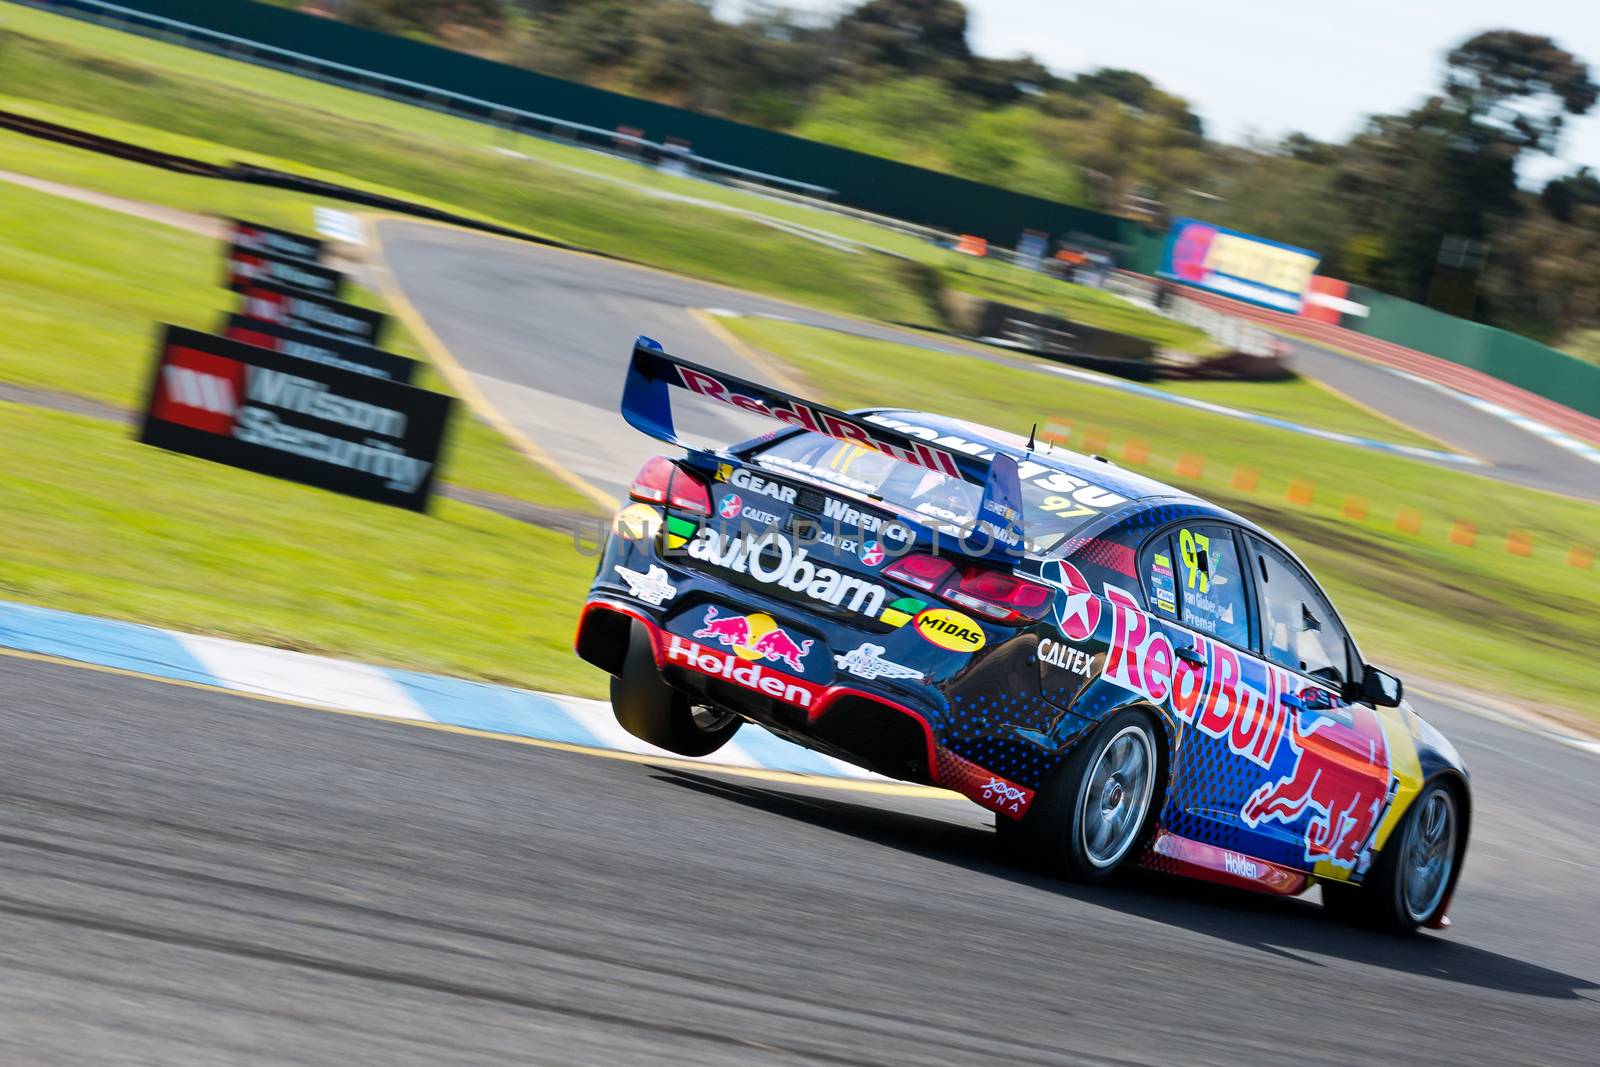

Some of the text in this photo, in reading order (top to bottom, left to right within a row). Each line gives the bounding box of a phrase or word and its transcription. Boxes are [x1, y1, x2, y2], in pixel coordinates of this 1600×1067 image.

[674, 364, 822, 433] Red
[731, 469, 798, 505] GEAR
[742, 506, 781, 525] CALTEX
[1039, 496, 1099, 519] 97
[819, 531, 858, 554] CALTEX
[1180, 529, 1209, 593] 97
[1184, 608, 1217, 633] Premat
[668, 636, 813, 707] Holden
[1037, 638, 1095, 678] CALTEX
[1101, 582, 1290, 770] Red Bull
[983, 789, 1018, 812] DNA
[1225, 852, 1257, 878] Holden
